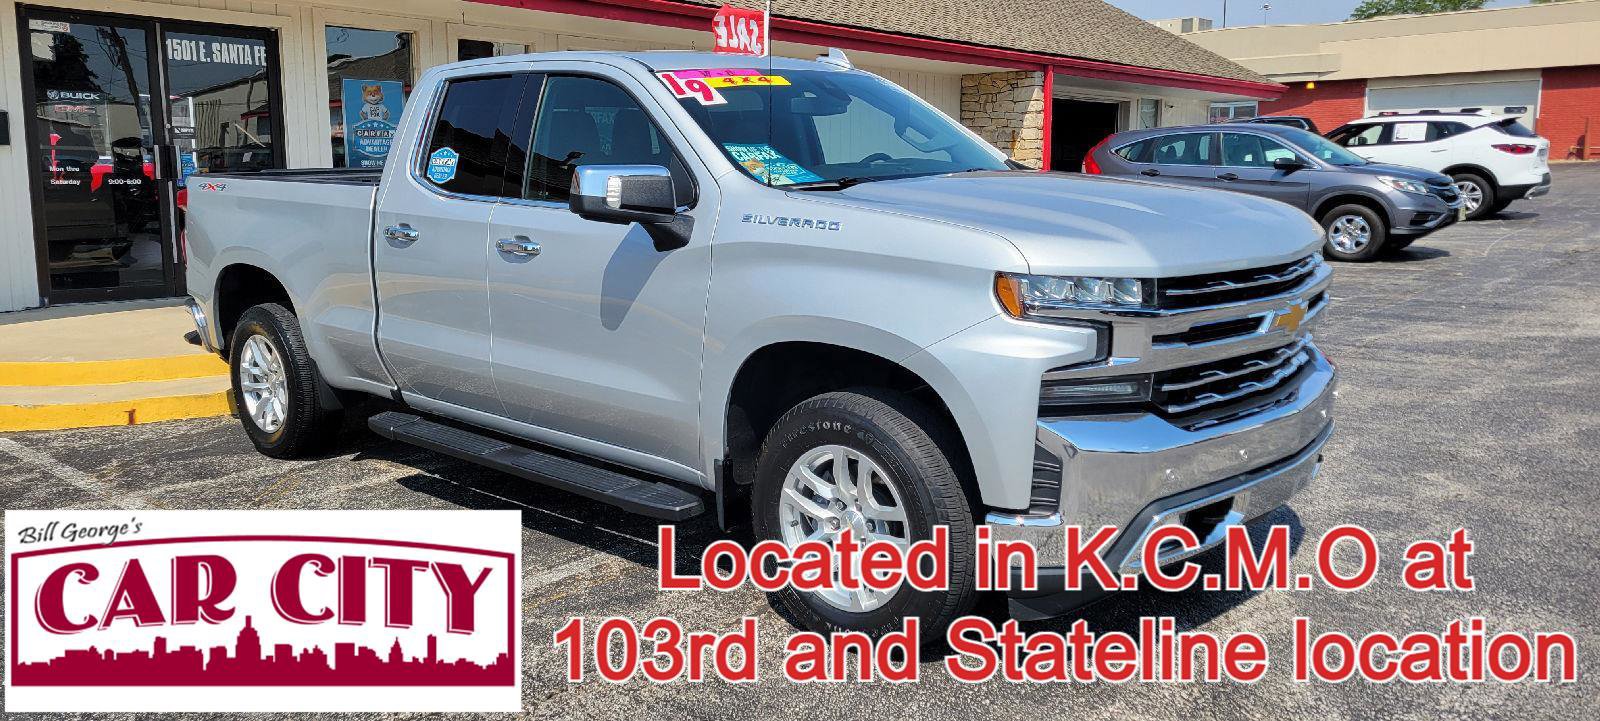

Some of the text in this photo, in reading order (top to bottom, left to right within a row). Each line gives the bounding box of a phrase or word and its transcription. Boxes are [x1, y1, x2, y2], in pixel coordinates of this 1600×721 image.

[166, 39, 267, 66] 1501 E. SANTA FE
[60, 91, 100, 99] BUICK
[662, 73, 714, 101] 19
[741, 213, 841, 231] SILVERADO
